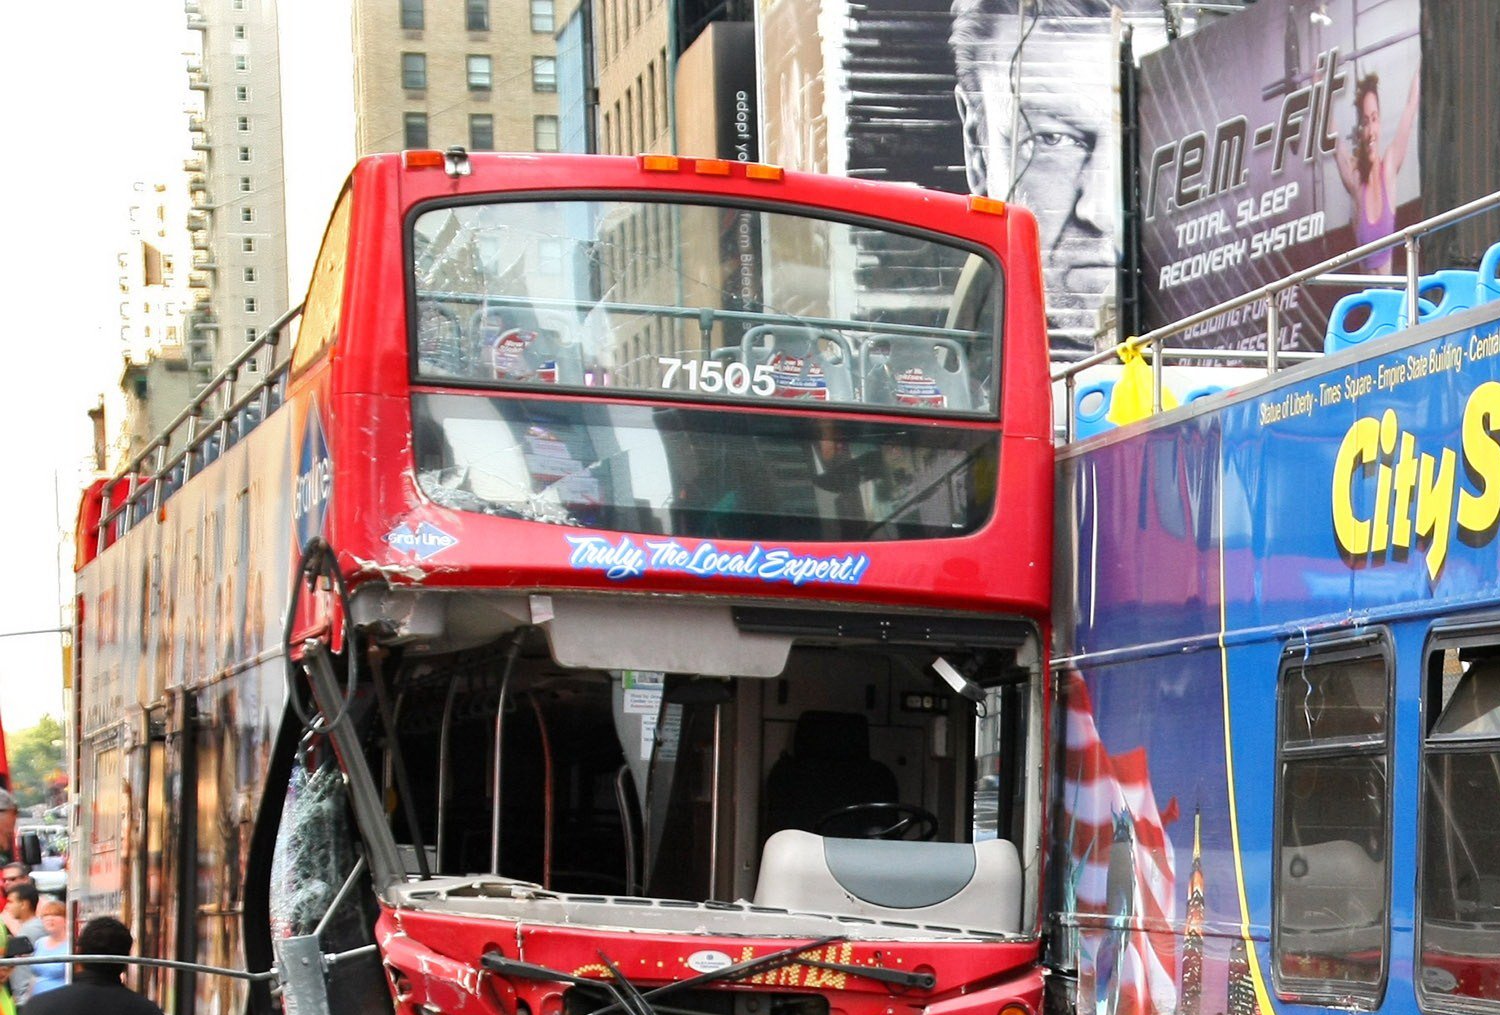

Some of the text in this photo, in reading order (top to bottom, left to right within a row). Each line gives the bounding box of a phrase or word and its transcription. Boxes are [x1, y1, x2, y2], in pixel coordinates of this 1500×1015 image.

[735, 90, 748, 138] adopt
[1176, 181, 1299, 249] TOTAL SLEEP
[1159, 210, 1326, 290] RECOVERY SYSTEM
[659, 358, 776, 397] 71505
[1260, 402, 1281, 425] Statue
[1281, 394, 1290, 419] of
[1290, 389, 1313, 416] Liberty
[1319, 383, 1341, 407] Times
[1344, 371, 1371, 402] Square
[1378, 362, 1405, 392] Empire
[1406, 354, 1428, 380] State
[1429, 341, 1462, 372] Building
[1469, 327, 1500, 361] Central
[566, 536, 866, 584] Truly, The Local Expert!
